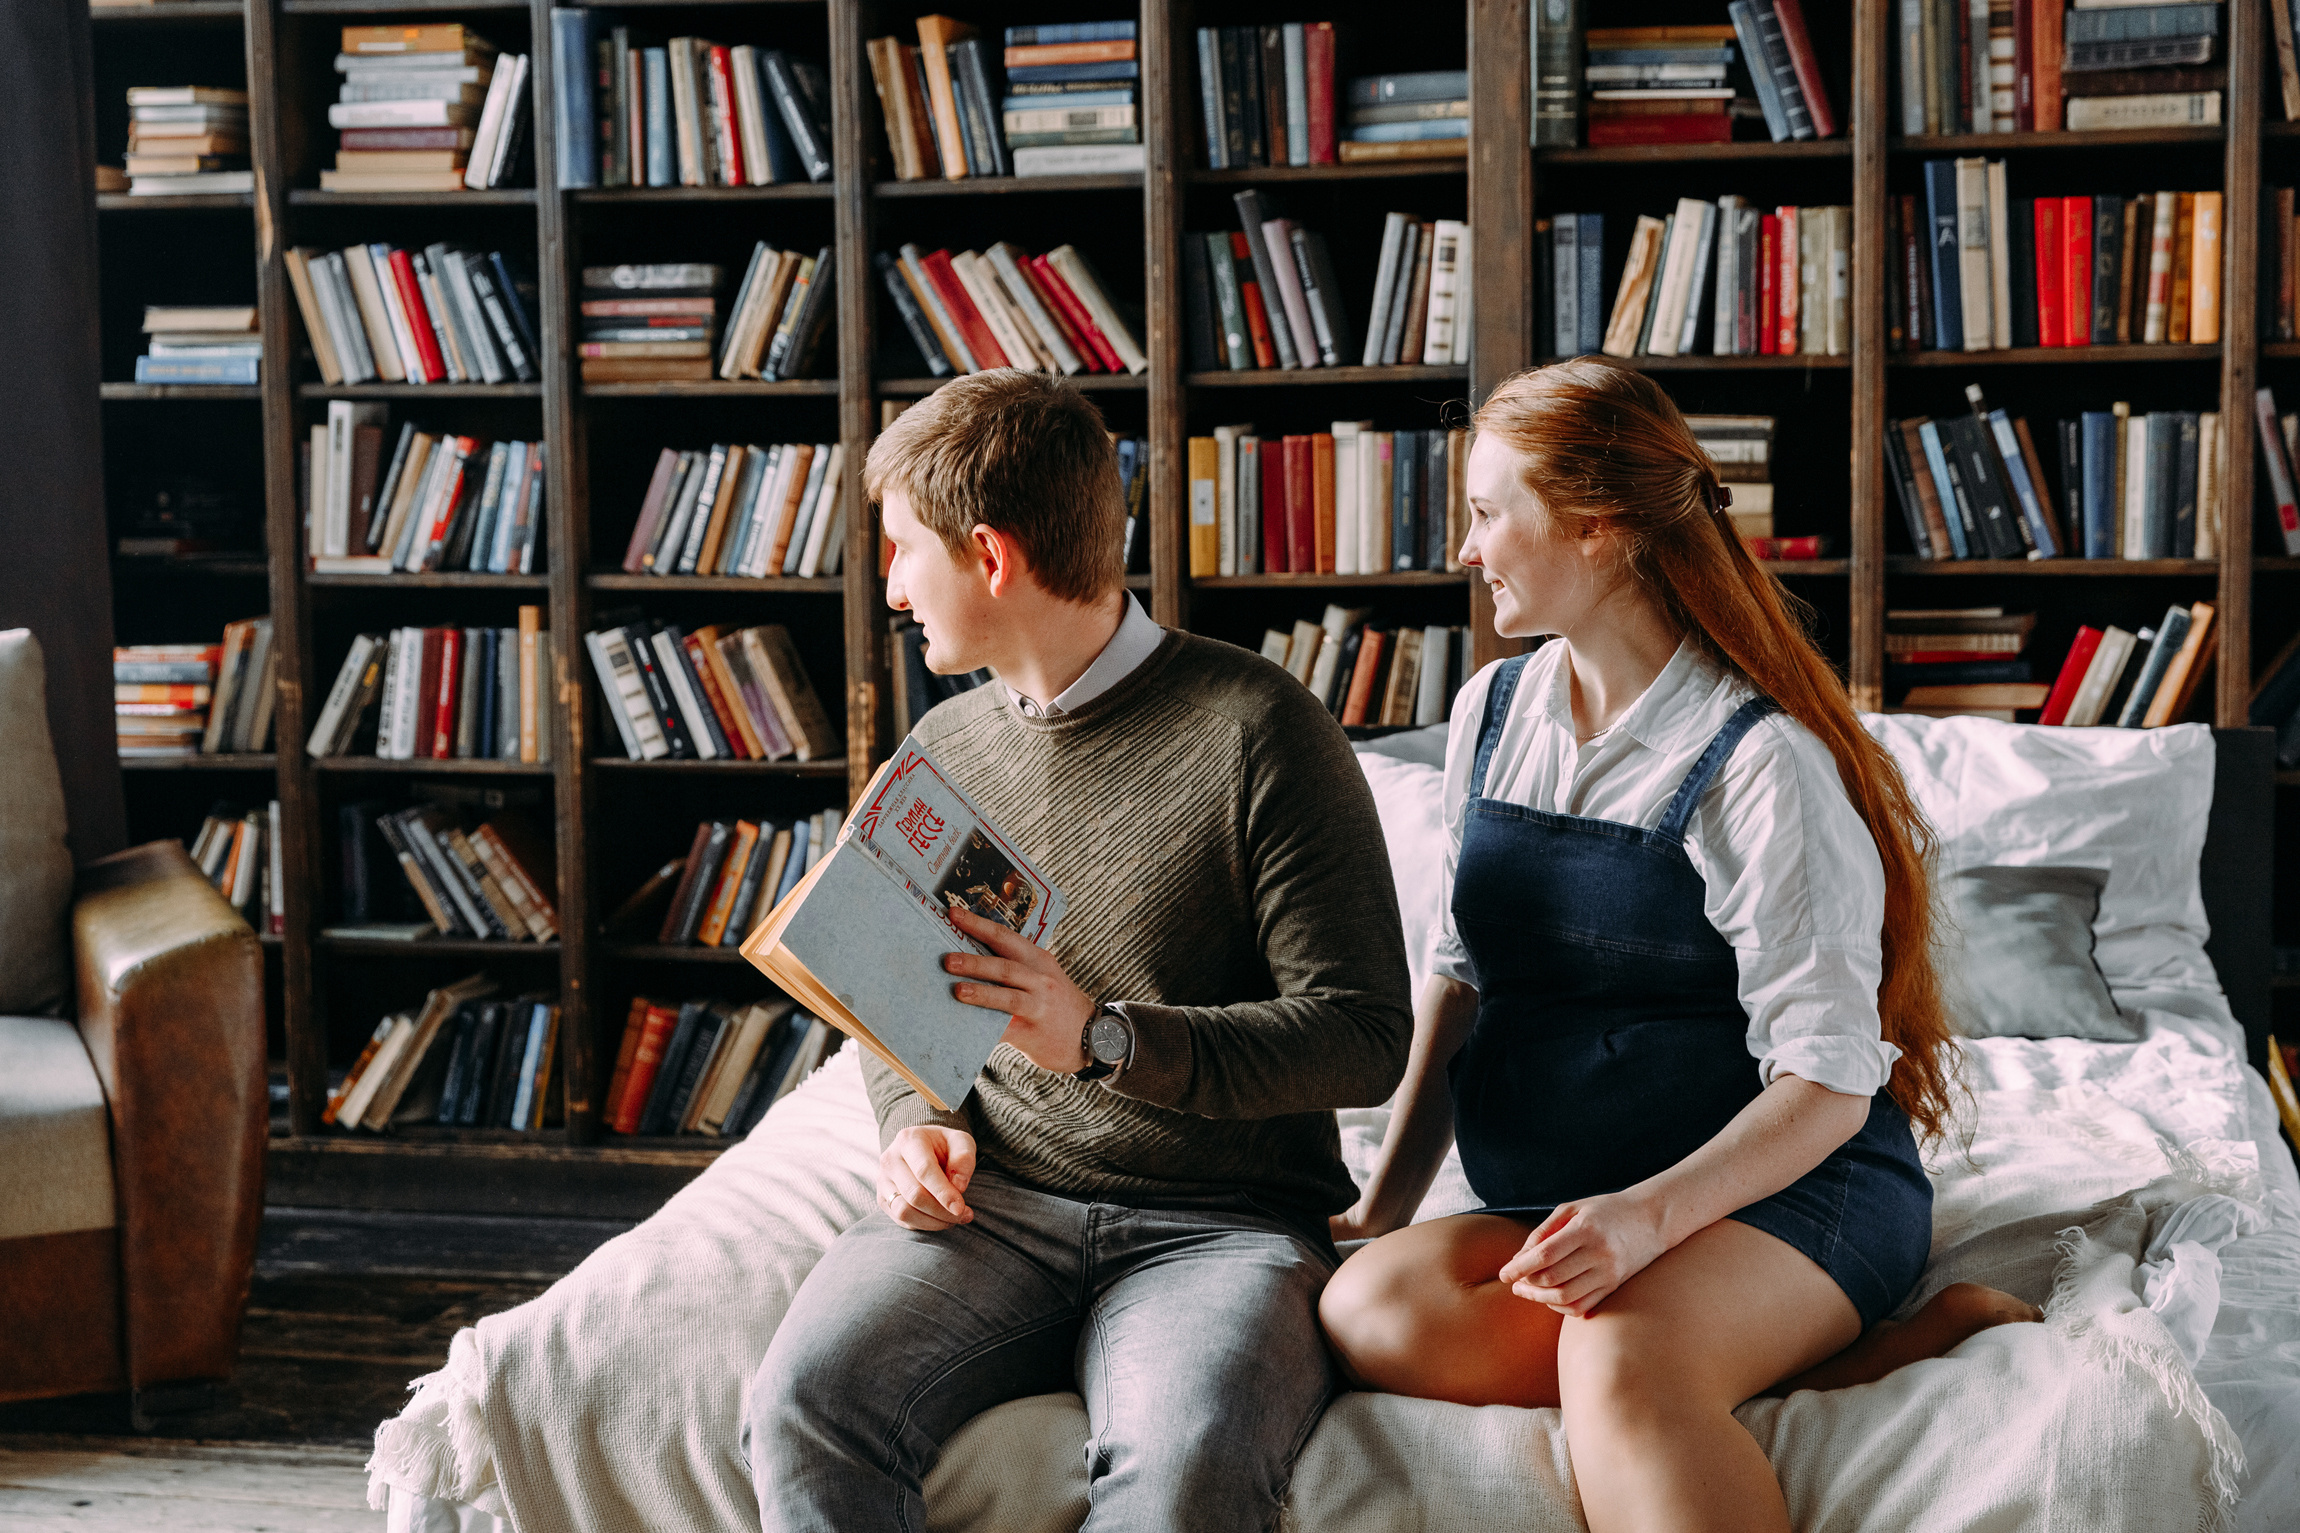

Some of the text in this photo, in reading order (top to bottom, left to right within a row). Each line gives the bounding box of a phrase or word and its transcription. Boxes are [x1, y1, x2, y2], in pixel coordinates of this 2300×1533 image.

[878, 773, 916, 828] ЗАРУБЕЖНАЯ КЛАССИКА
[895, 797, 928, 838] ГЕРМАН
[899, 795, 908, 807] ВЕК
[907, 806, 946, 858] ГЕССЕ
[927, 839, 952, 875] Степной
